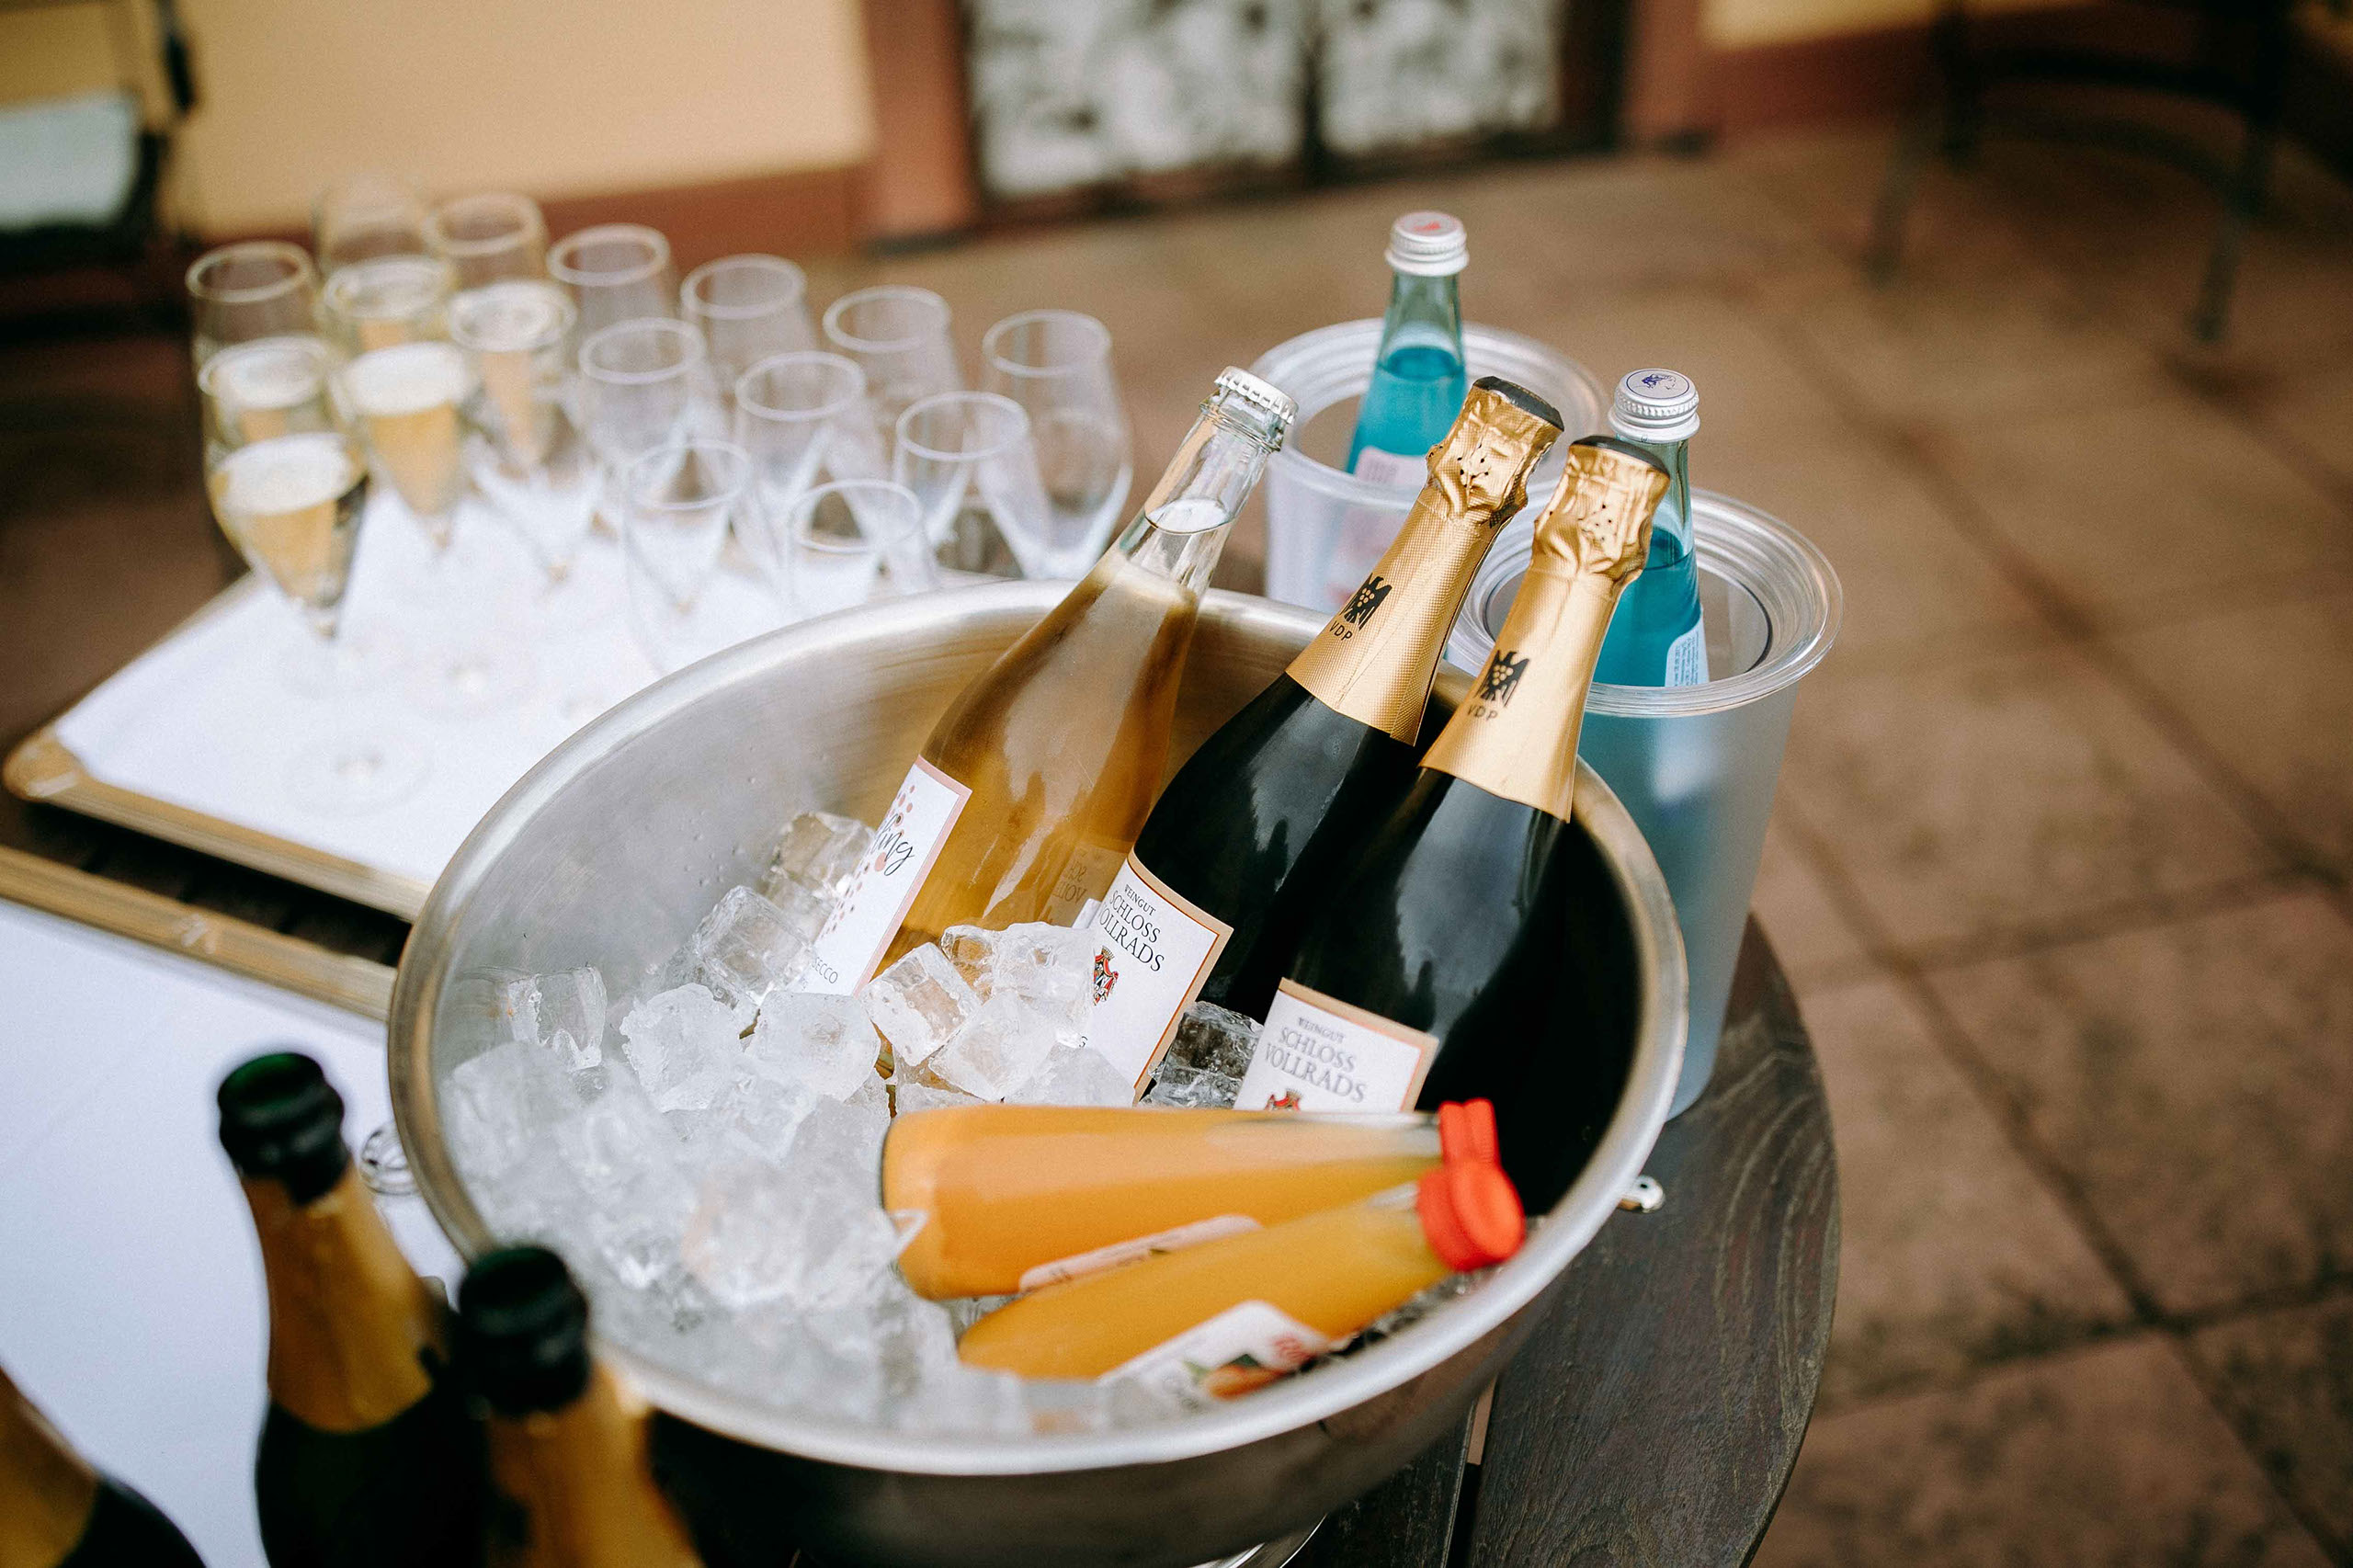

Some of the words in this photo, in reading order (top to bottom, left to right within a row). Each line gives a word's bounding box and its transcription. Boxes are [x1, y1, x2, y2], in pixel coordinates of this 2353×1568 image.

[1329, 620, 1353, 641] VDP
[1467, 704, 1498, 722] VDP
[1109, 890, 1161, 943] SCHLOSS
[1124, 883, 1156, 916] WEINGUT
[1279, 1027, 1356, 1073] SCHLOSS
[1266, 1042, 1366, 1103] VOLLRADS
